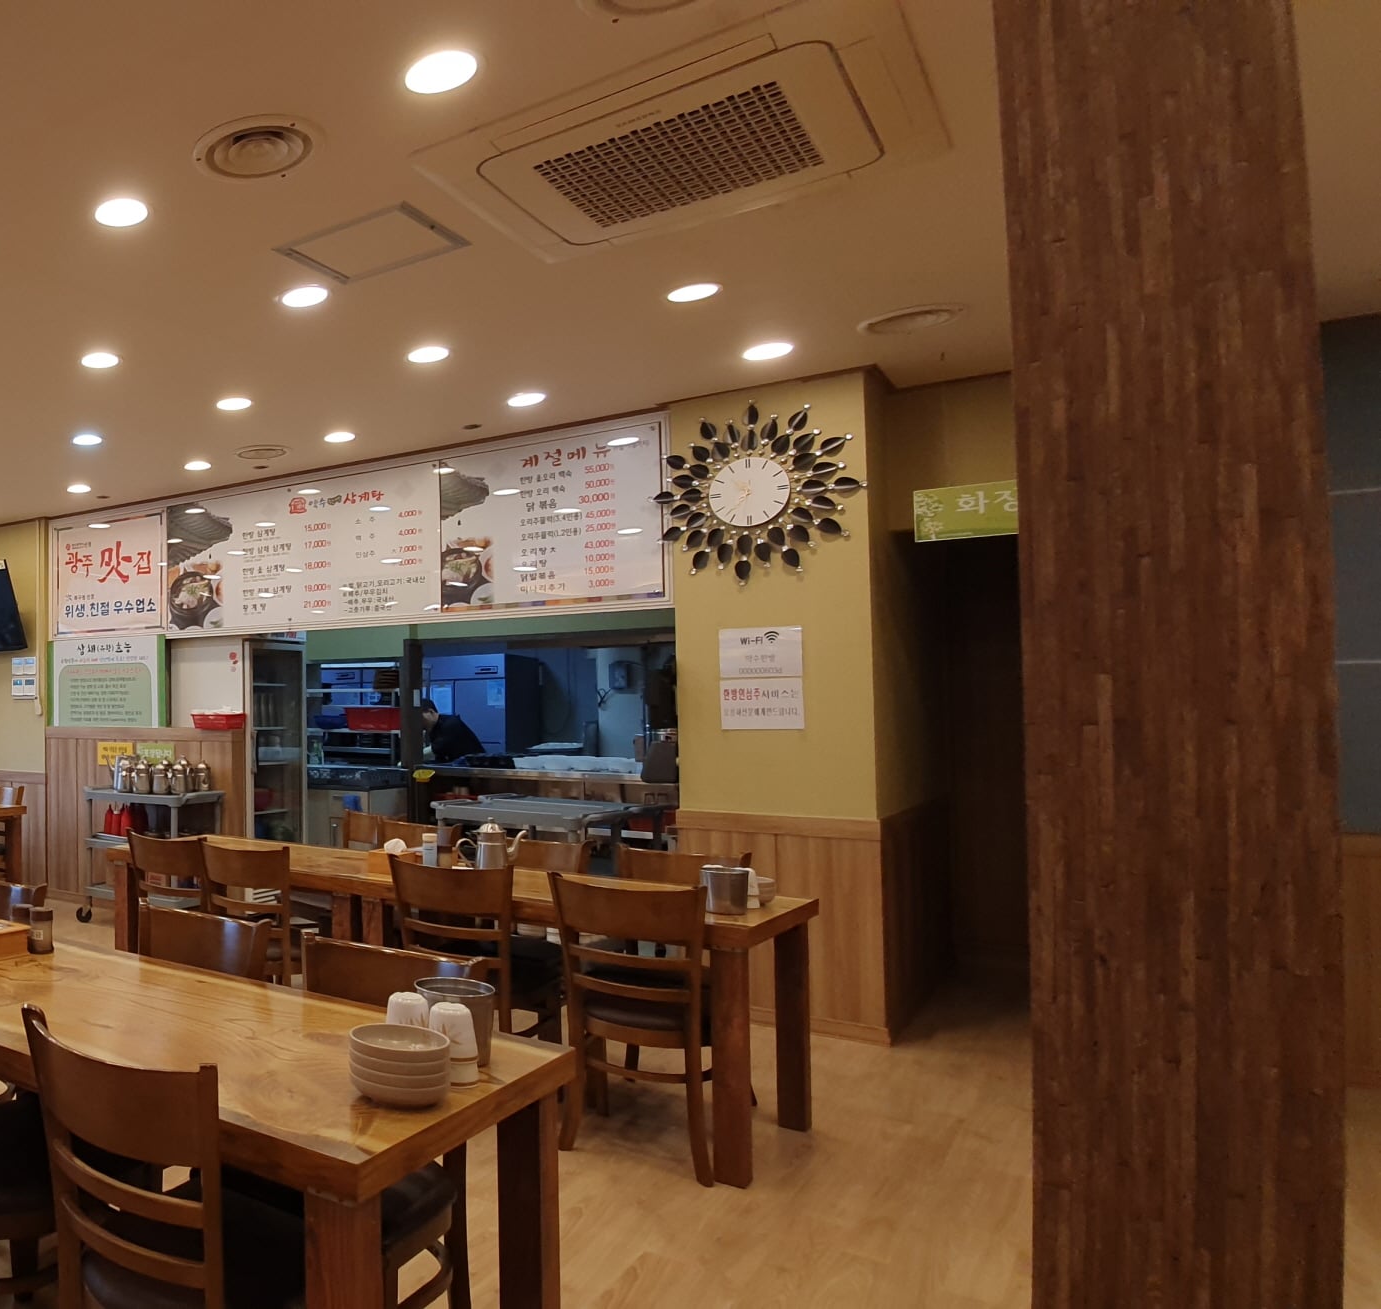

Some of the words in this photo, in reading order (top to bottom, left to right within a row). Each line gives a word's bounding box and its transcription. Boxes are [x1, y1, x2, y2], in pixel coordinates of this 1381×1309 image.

[343, 490, 385, 504] 삼계탕
[65, 551, 94, 578] 광주
[97, 540, 152, 584] 맛집
[113, 598, 156, 614] 우수업소
